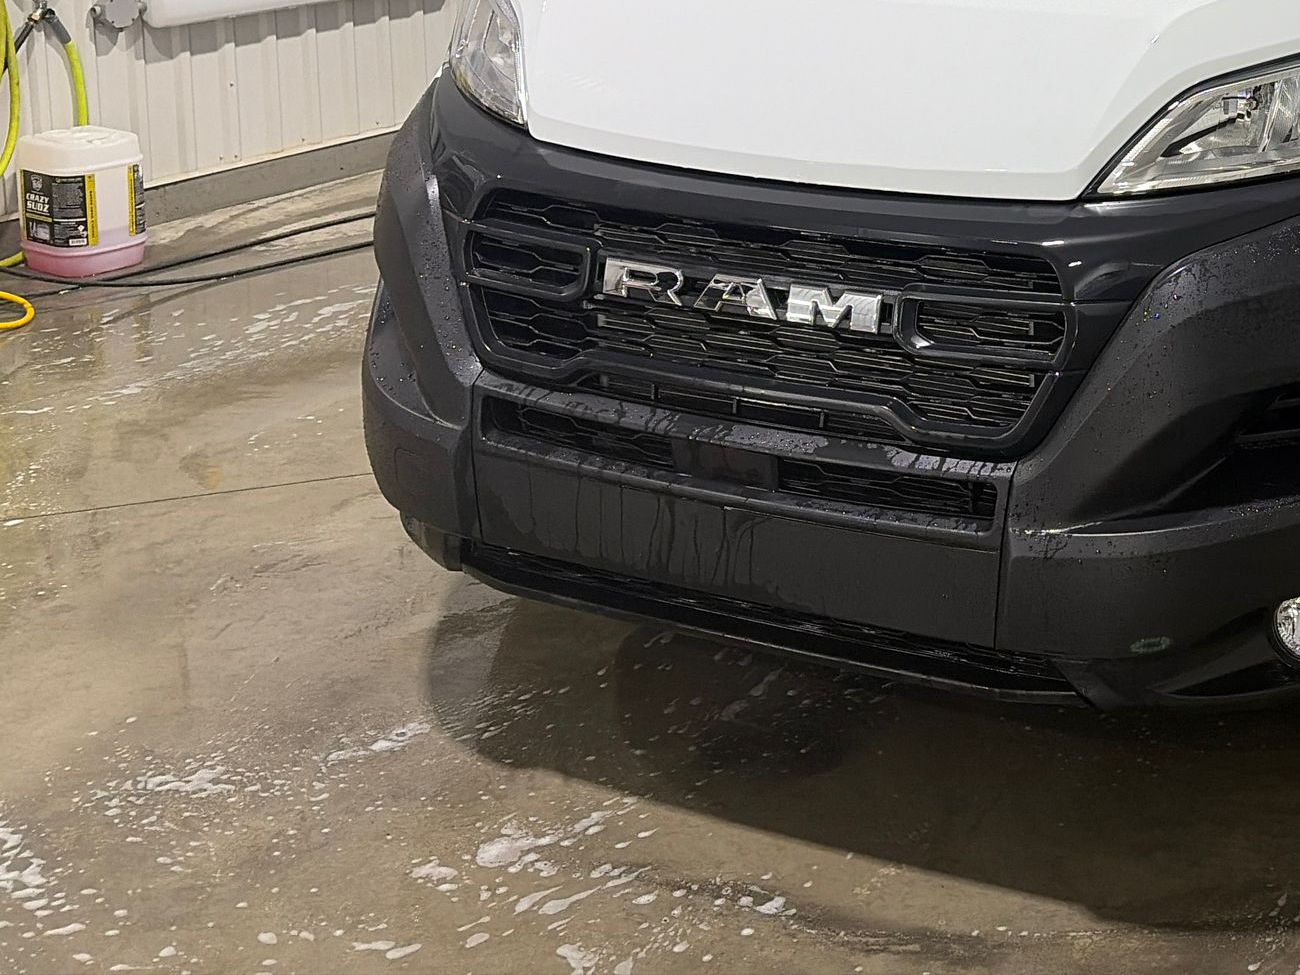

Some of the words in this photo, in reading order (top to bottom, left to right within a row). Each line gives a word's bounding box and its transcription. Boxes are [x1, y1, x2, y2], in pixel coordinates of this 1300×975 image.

[26, 193, 50, 204] CRAZY
[26, 201, 50, 213] SUDZ
[603, 257, 884, 335] RAM
